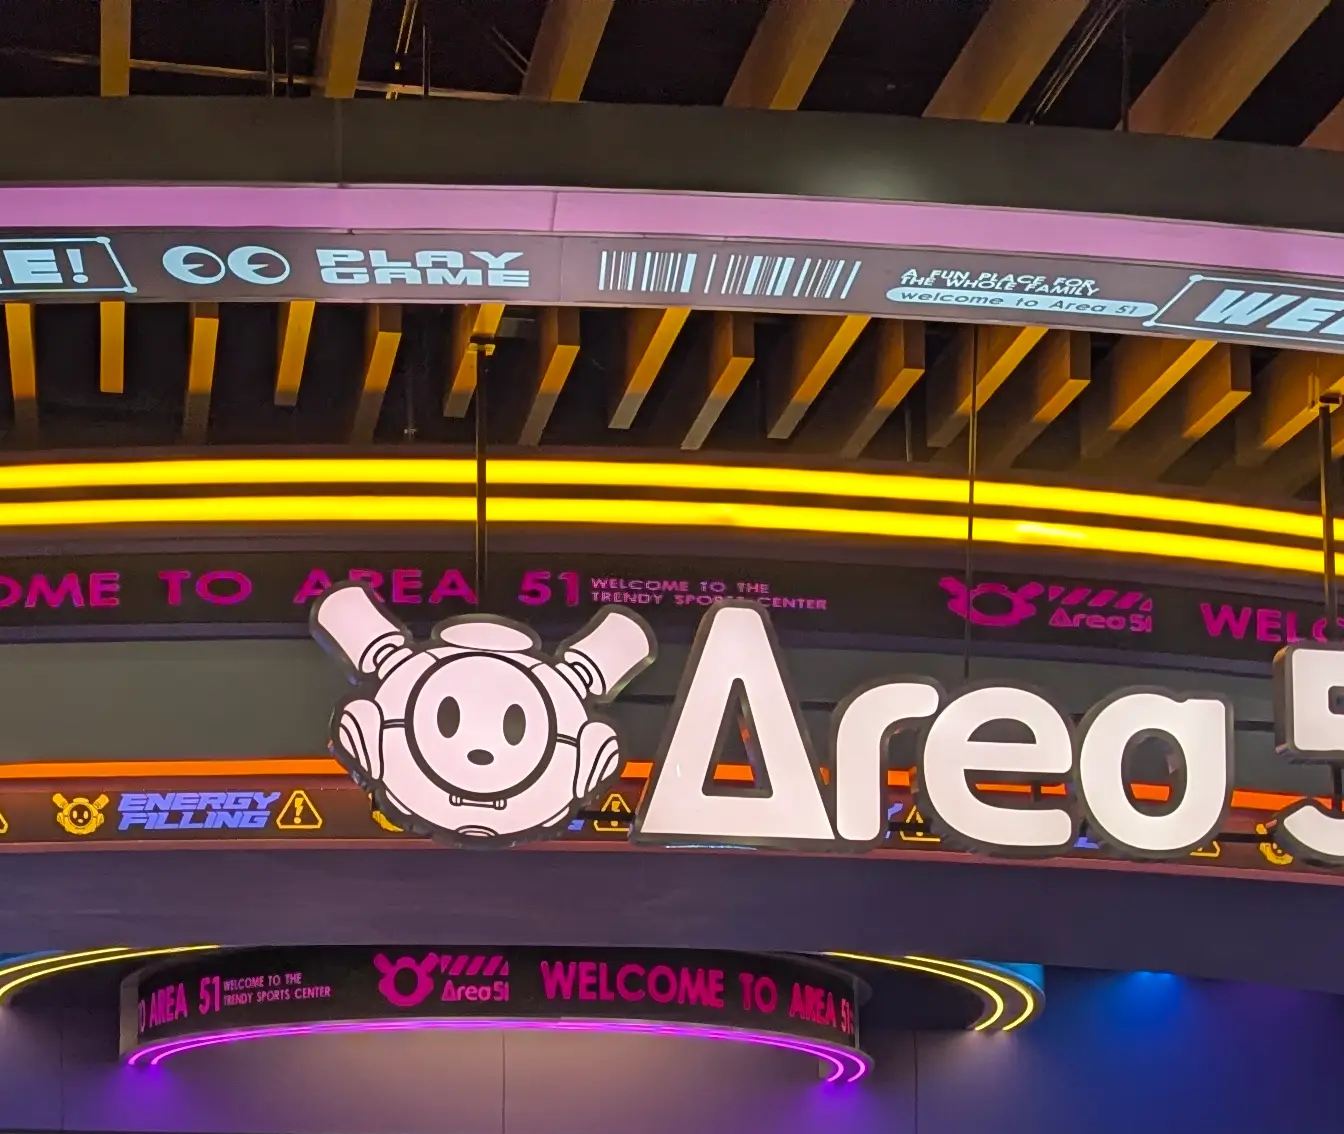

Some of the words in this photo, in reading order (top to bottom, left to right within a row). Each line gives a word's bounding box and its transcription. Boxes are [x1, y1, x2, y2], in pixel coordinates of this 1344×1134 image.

[315, 248, 525, 269] PLAY
[320, 266, 530, 288] GAME
[901, 276, 936, 287] THE
[946, 278, 1018, 292] WHOLE
[1024, 283, 1101, 297] FAMILY
[978, 272, 1047, 285] PLACE
[1052, 277, 1096, 289] FOR
[900, 290, 1005, 306] welcome
[1015, 296, 1039, 308] to
[1047, 300, 1107, 314] Area
[1114, 304, 1138, 316] 51
[158, 570, 253, 606] TO
[518, 571, 579, 606] 51
[591, 577, 689, 593] WELCOME
[699, 581, 727, 593] TO
[737, 582, 770, 594] THE
[591, 591, 663, 605] TRENDY
[1049, 607, 1124, 631] Area
[1130, 611, 1153, 633] 51
[640, 607, 1229, 850] Area
[118, 791, 282, 813] ENERGY
[117, 808, 272, 832] FILLING
[223, 976, 265, 991] WELCOME
[268, 974, 281, 986] TO
[285, 972, 302, 985] THE
[440, 979, 491, 1001] Area
[493, 980, 509, 1001] 51
[149, 983, 189, 1028] AREA
[198, 976, 221, 1015] 51
[223, 992, 252, 1006] TRENDY
[256, 989, 291, 1003] SPORTS
[294, 986, 331, 999] CENTER
[540, 960, 724, 1009] WELCOME
[738, 972, 777, 1013] TO
[789, 982, 836, 1029] AREA
